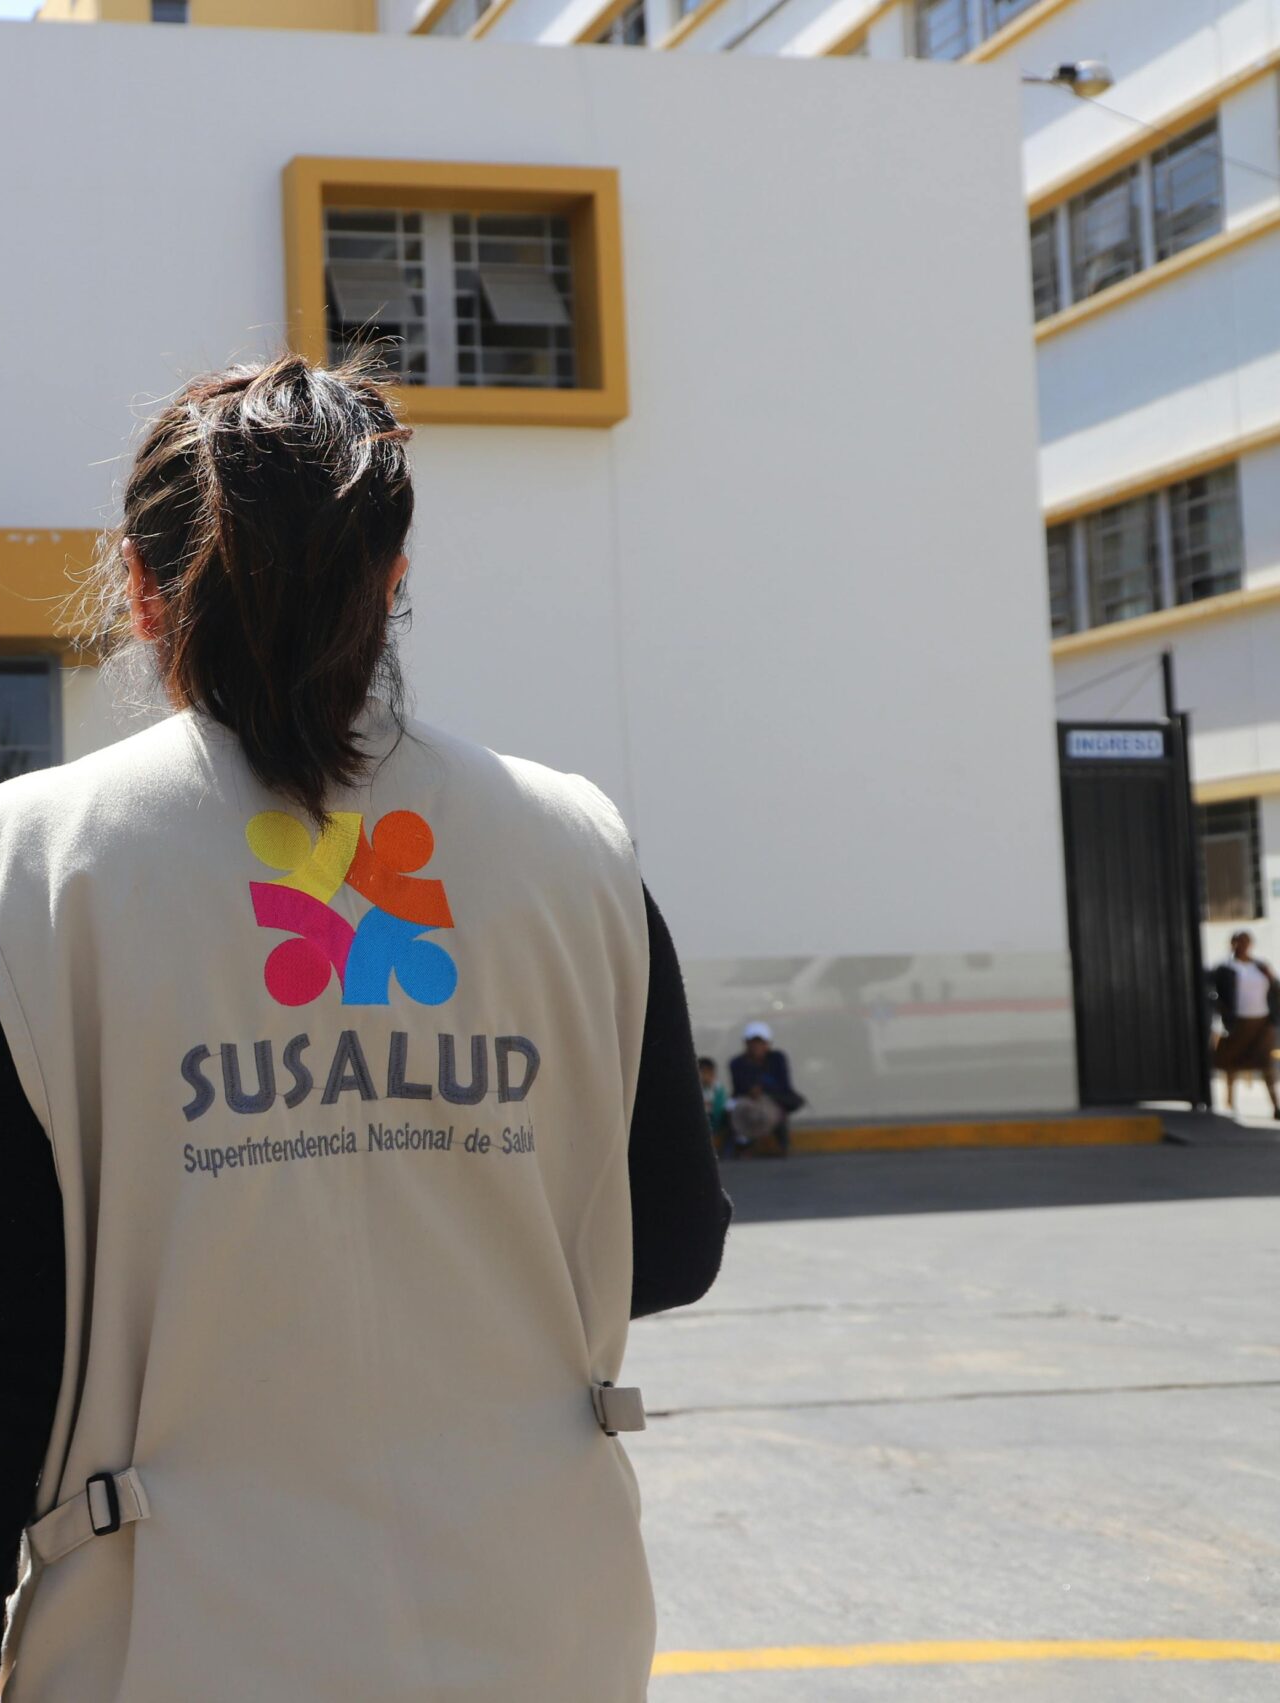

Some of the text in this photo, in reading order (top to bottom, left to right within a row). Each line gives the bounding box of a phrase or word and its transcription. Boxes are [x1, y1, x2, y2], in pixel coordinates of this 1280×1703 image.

[1075, 736, 1160, 752] INGRESO
[180, 1030, 541, 1122] SUSALUD
[183, 1125, 357, 1178] Superintendencia
[368, 1122, 454, 1152] Nacional
[464, 1127, 491, 1154] de
